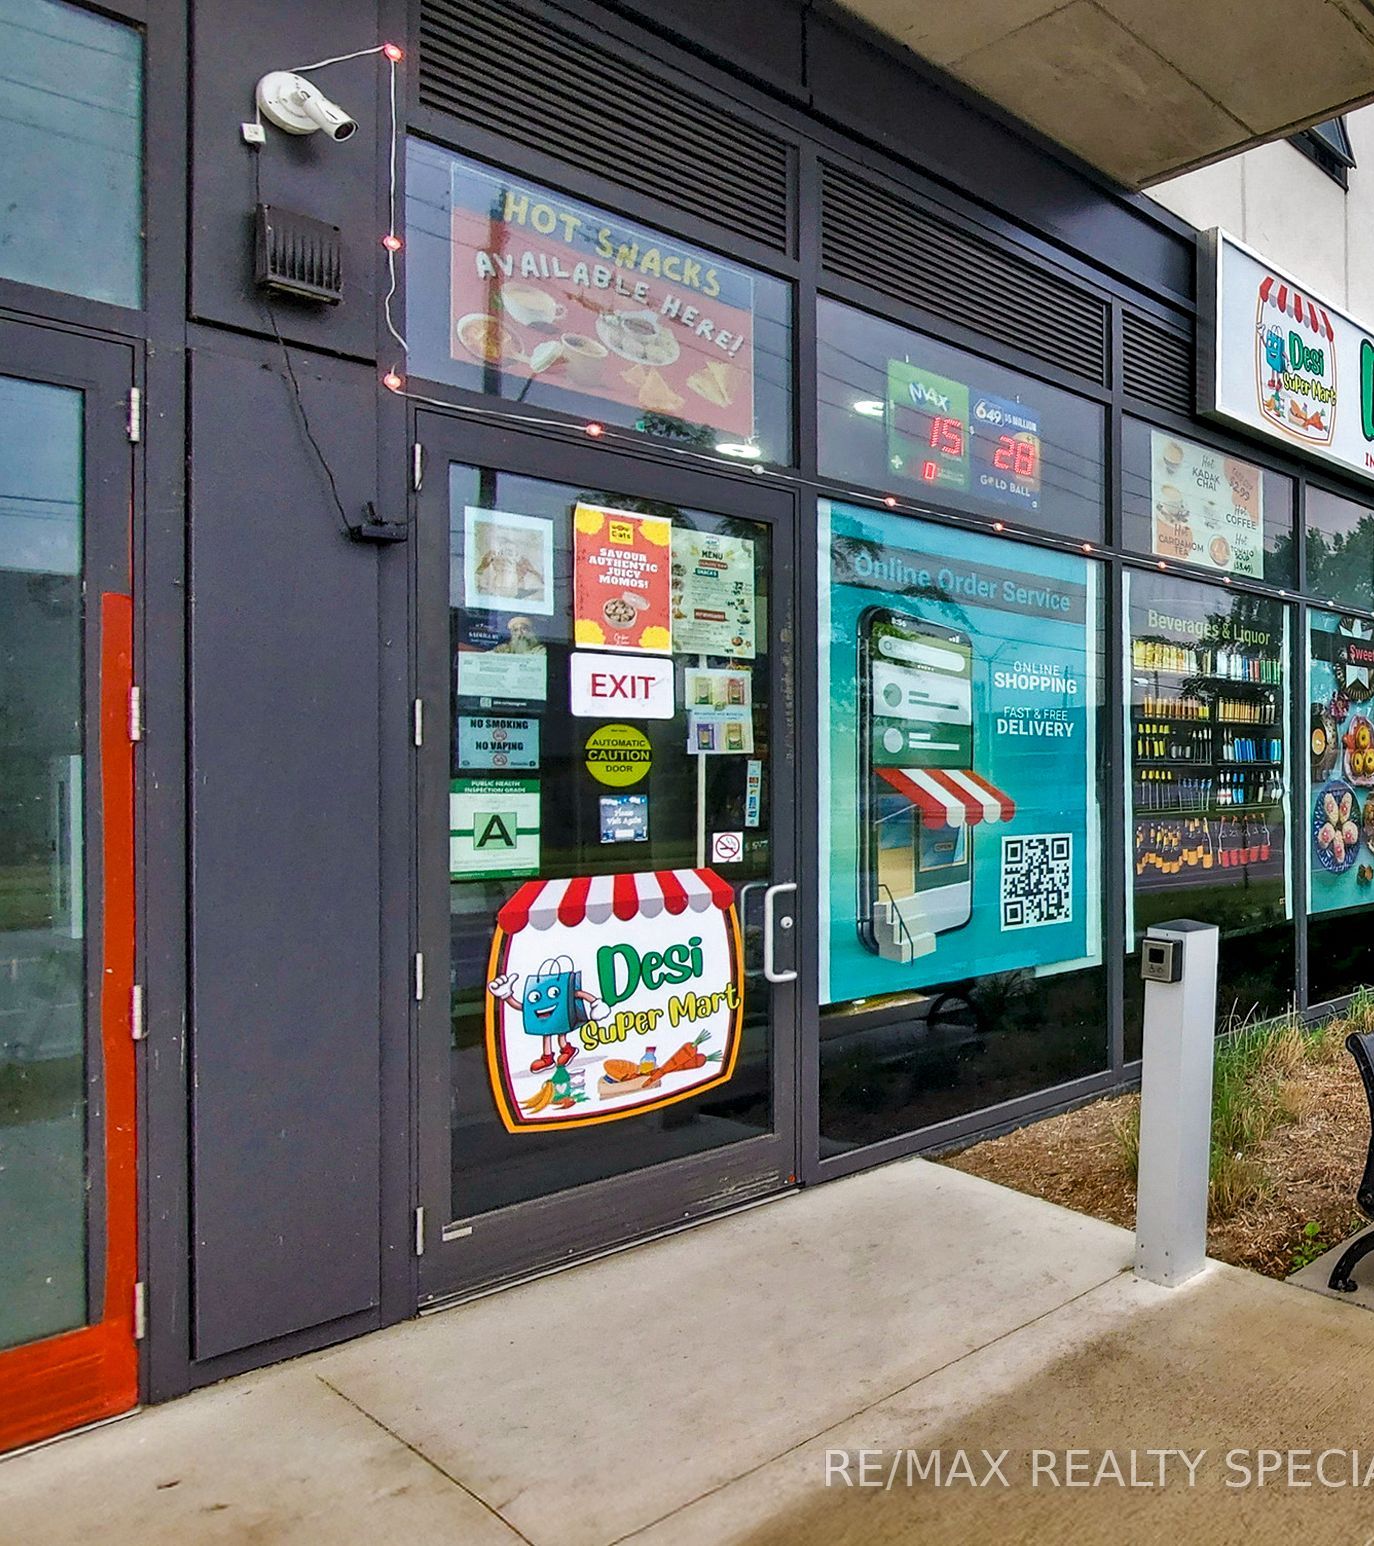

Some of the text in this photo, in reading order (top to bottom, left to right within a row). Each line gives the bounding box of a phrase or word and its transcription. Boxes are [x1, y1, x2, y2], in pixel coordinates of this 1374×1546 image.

[503, 191, 722, 298] HOT SNACKS
[475, 250, 745, 358] AVAILABLE HERE!
[1289, 330, 1325, 377] Desi
[1311, 378, 1337, 407] Mart
[929, 416, 964, 457] 15
[993, 434, 1036, 477] 28
[1192, 467, 1221, 485] KADAK
[1196, 478, 1217, 492] CHAI
[1009, 482, 1031, 498] BALL
[1225, 513, 1257, 531] COFFEE
[1158, 533, 1204, 553] CARDAMOM
[1174, 545, 1190, 557] TEA
[600, 547, 647, 562] SAVOUR
[701, 550, 723, 561] MENU
[588, 555, 659, 573] AUTHENTIC
[606, 566, 641, 579] JUICY
[598, 574, 649, 589] MOMOS!
[854, 551, 1071, 612] Online Order Service
[1148, 608, 1271, 648] Beverages & Liquor
[1013, 660, 1060, 676] ONLINE
[590, 673, 655, 699] EXIT
[994, 671, 1077, 695] SHOPPING
[1003, 706, 1068, 721] FAST & FREE
[470, 719, 529, 730] NO SMOKING
[997, 718, 1075, 738] DELIVERY
[475, 741, 524, 751] NO VAPING
[592, 739, 646, 747] AUTOMATIC
[588, 750, 650, 761] CAUTION
[605, 765, 633, 773] DOOR
[476, 814, 514, 848] A
[596, 936, 704, 1007] Desi
[579, 982, 742, 1051] Super Mart
